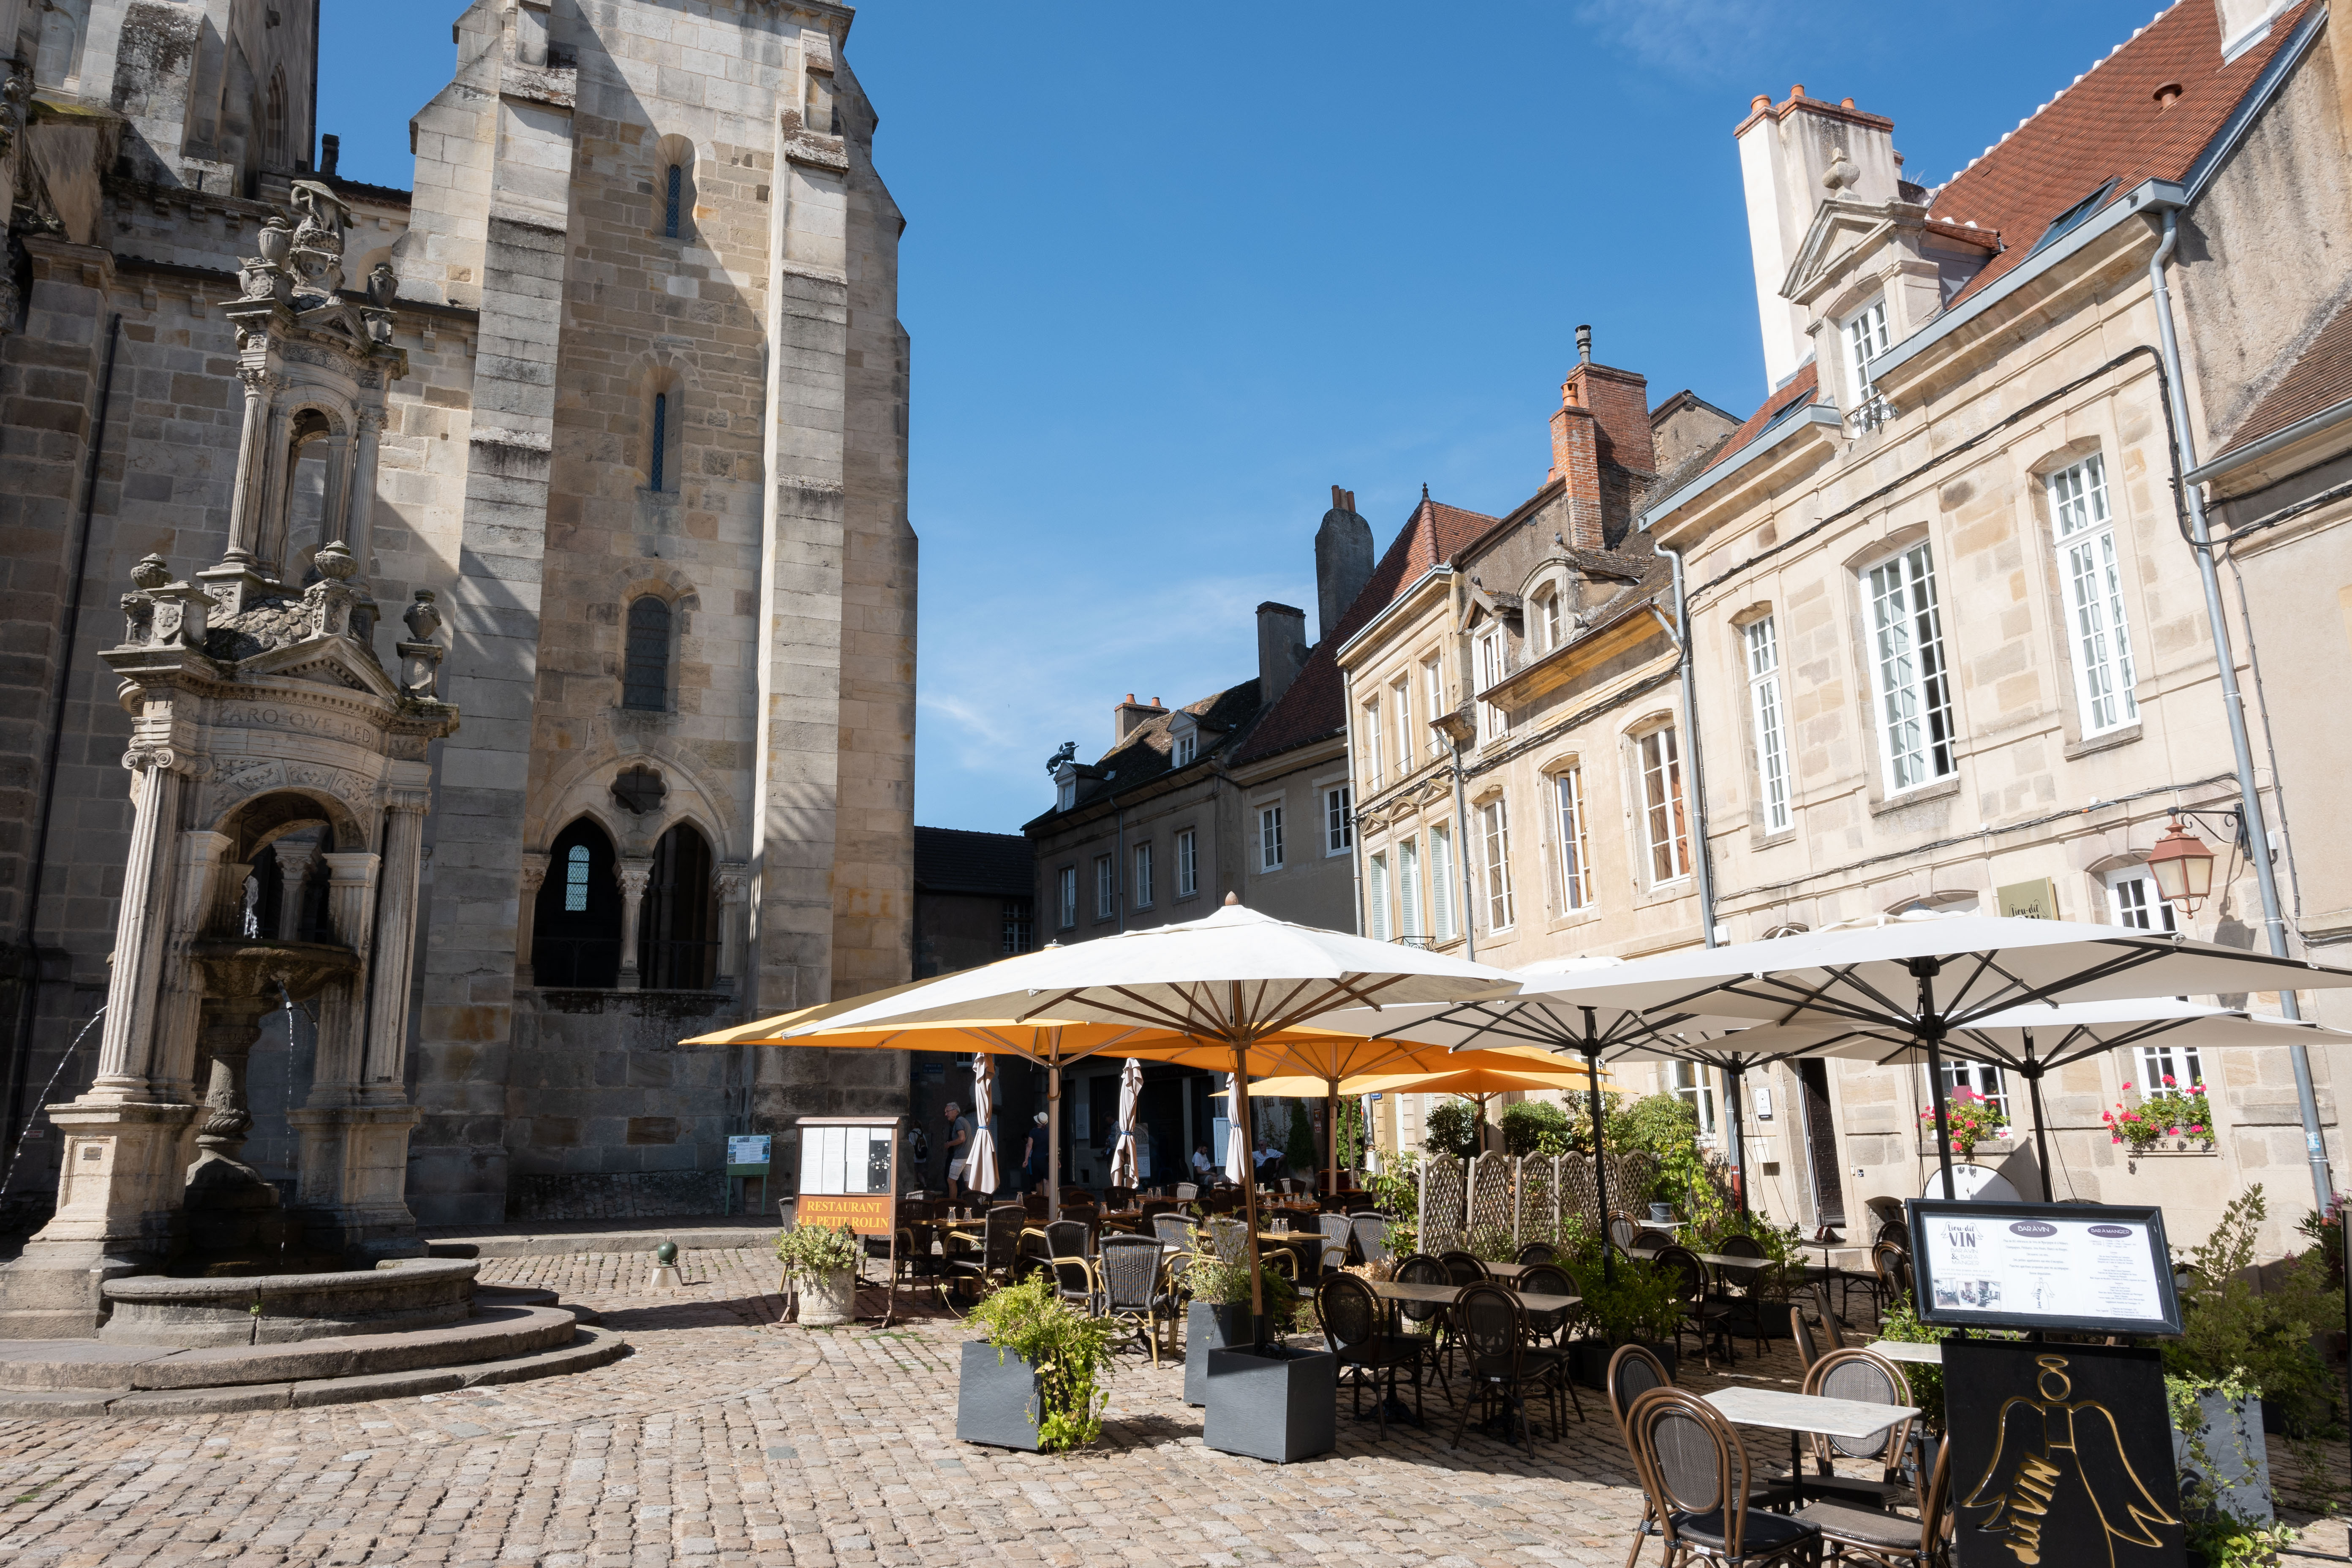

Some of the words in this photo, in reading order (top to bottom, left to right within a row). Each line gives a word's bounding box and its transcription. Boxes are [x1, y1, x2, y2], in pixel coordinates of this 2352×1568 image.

[806, 1201, 882, 1213] RESTAURANT
[817, 1216, 849, 1226] PETIT
[852, 1217, 889, 1228] ROLIN
[1949, 1232, 1976, 1247] VIN
[2008, 1451, 2061, 1516] VIN
